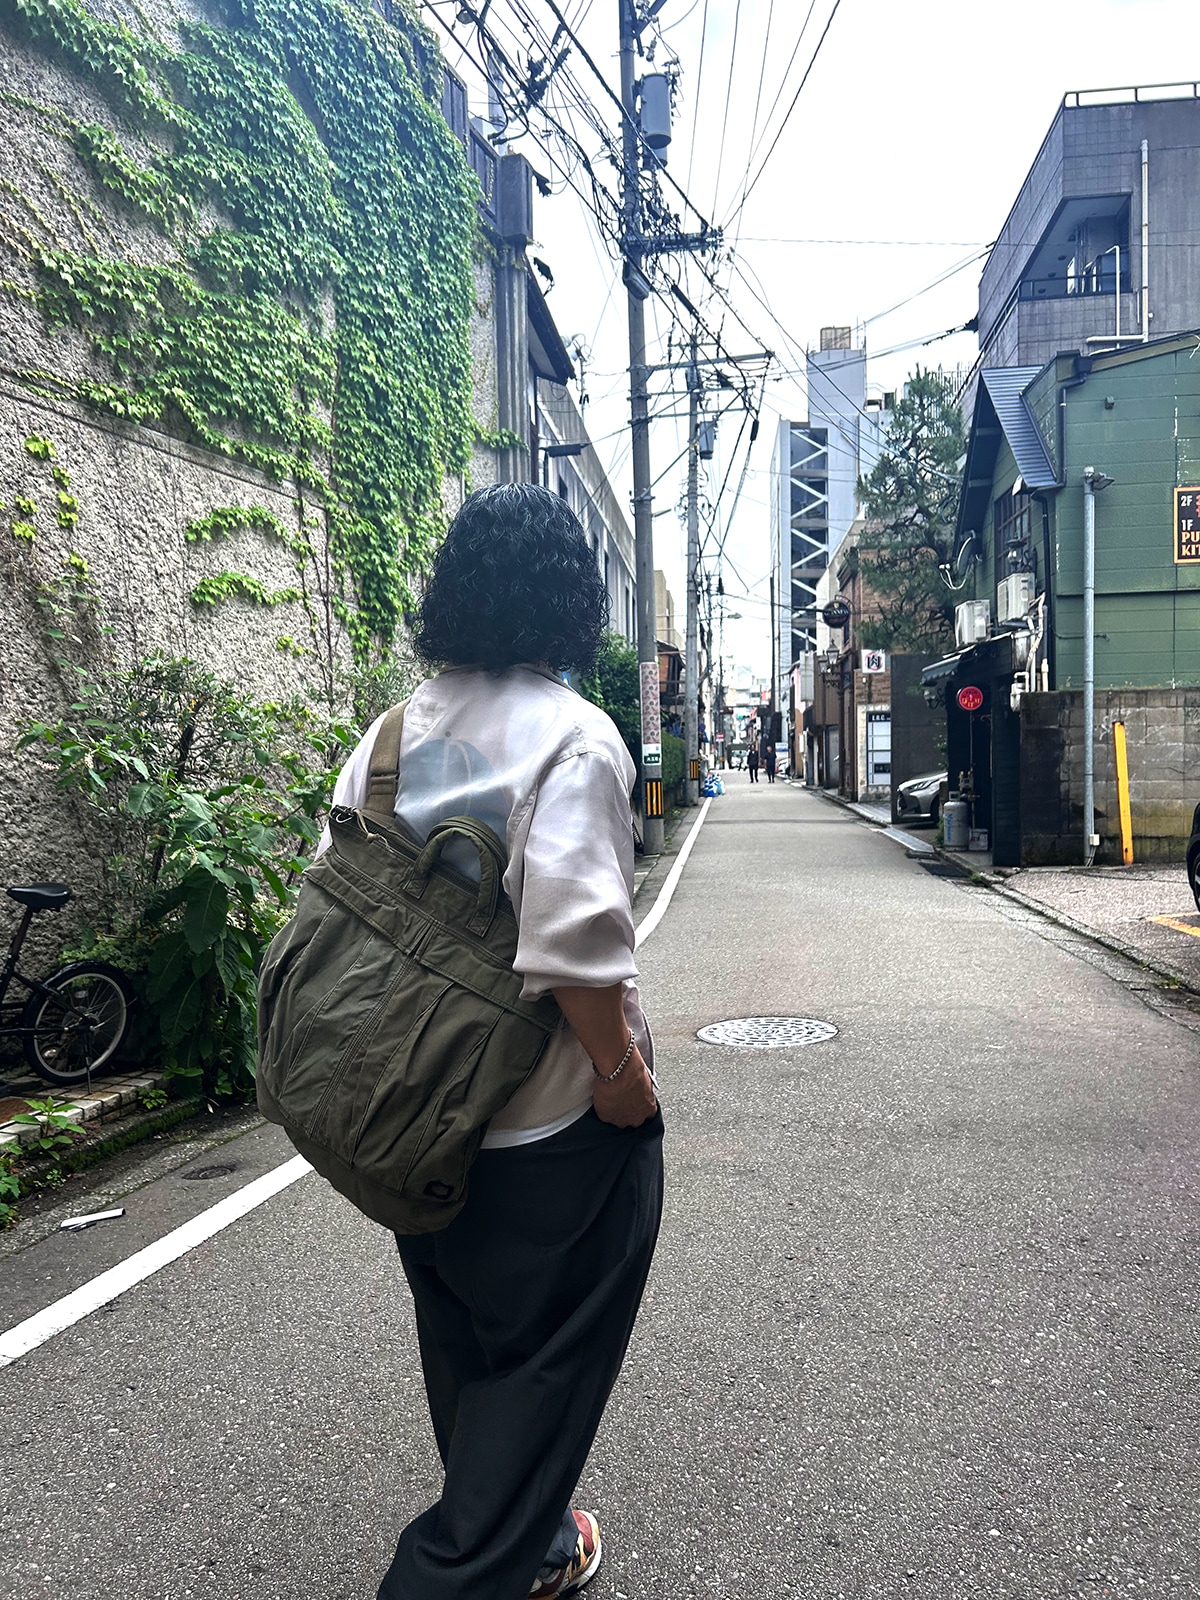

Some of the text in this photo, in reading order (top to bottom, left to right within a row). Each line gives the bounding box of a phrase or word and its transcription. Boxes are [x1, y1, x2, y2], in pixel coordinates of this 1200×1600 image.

[1181, 495, 1193, 507] 2F
[1182, 519, 1193, 531] 1F
[1181, 531, 1200, 543] PU
